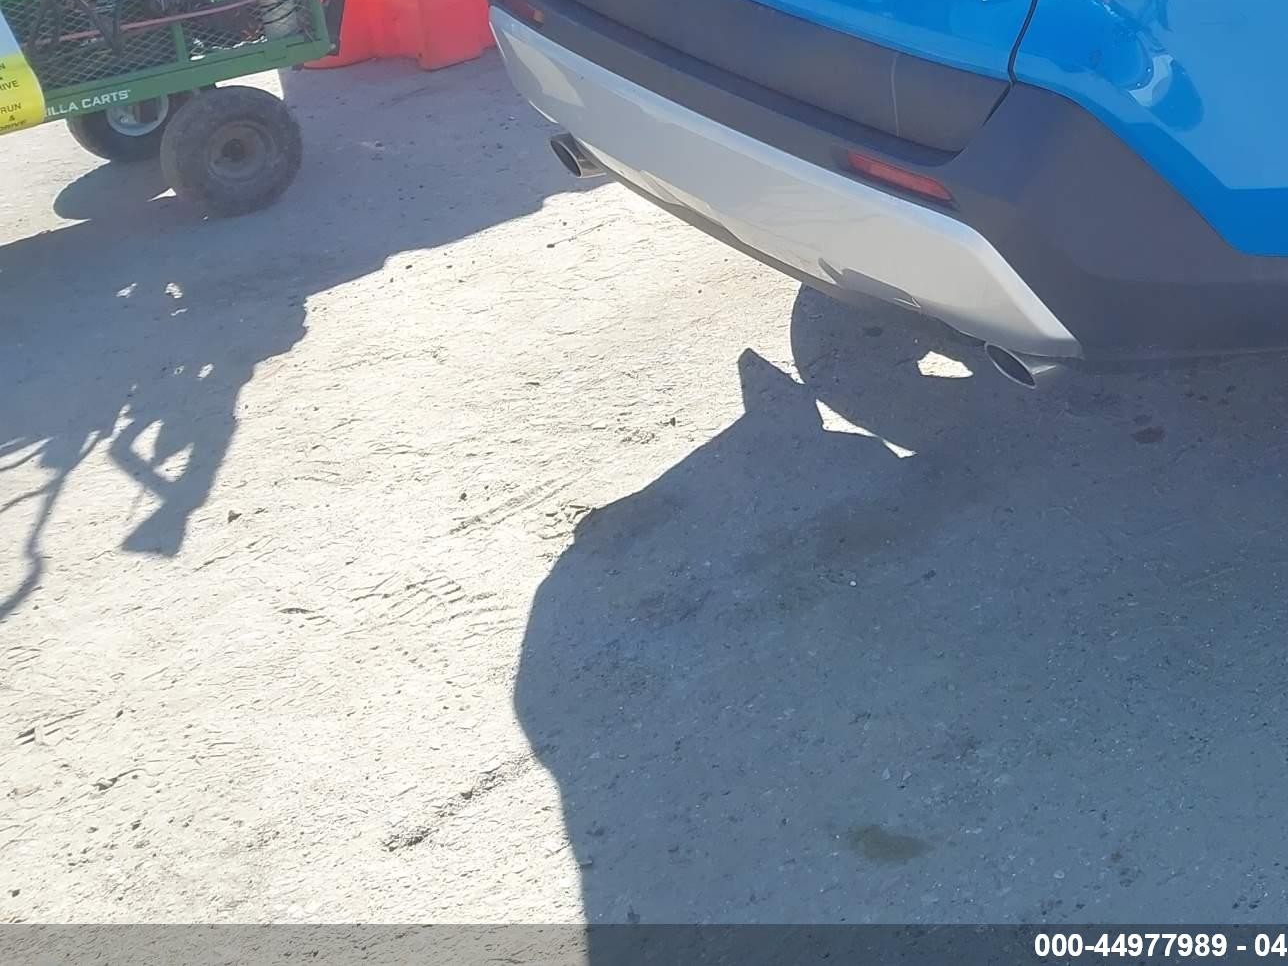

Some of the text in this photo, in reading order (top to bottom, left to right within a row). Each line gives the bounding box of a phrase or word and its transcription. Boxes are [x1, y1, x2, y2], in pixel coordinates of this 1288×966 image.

[0, 102, 21, 113] RUN
[47, 89, 130, 117] ILLA CARTS
